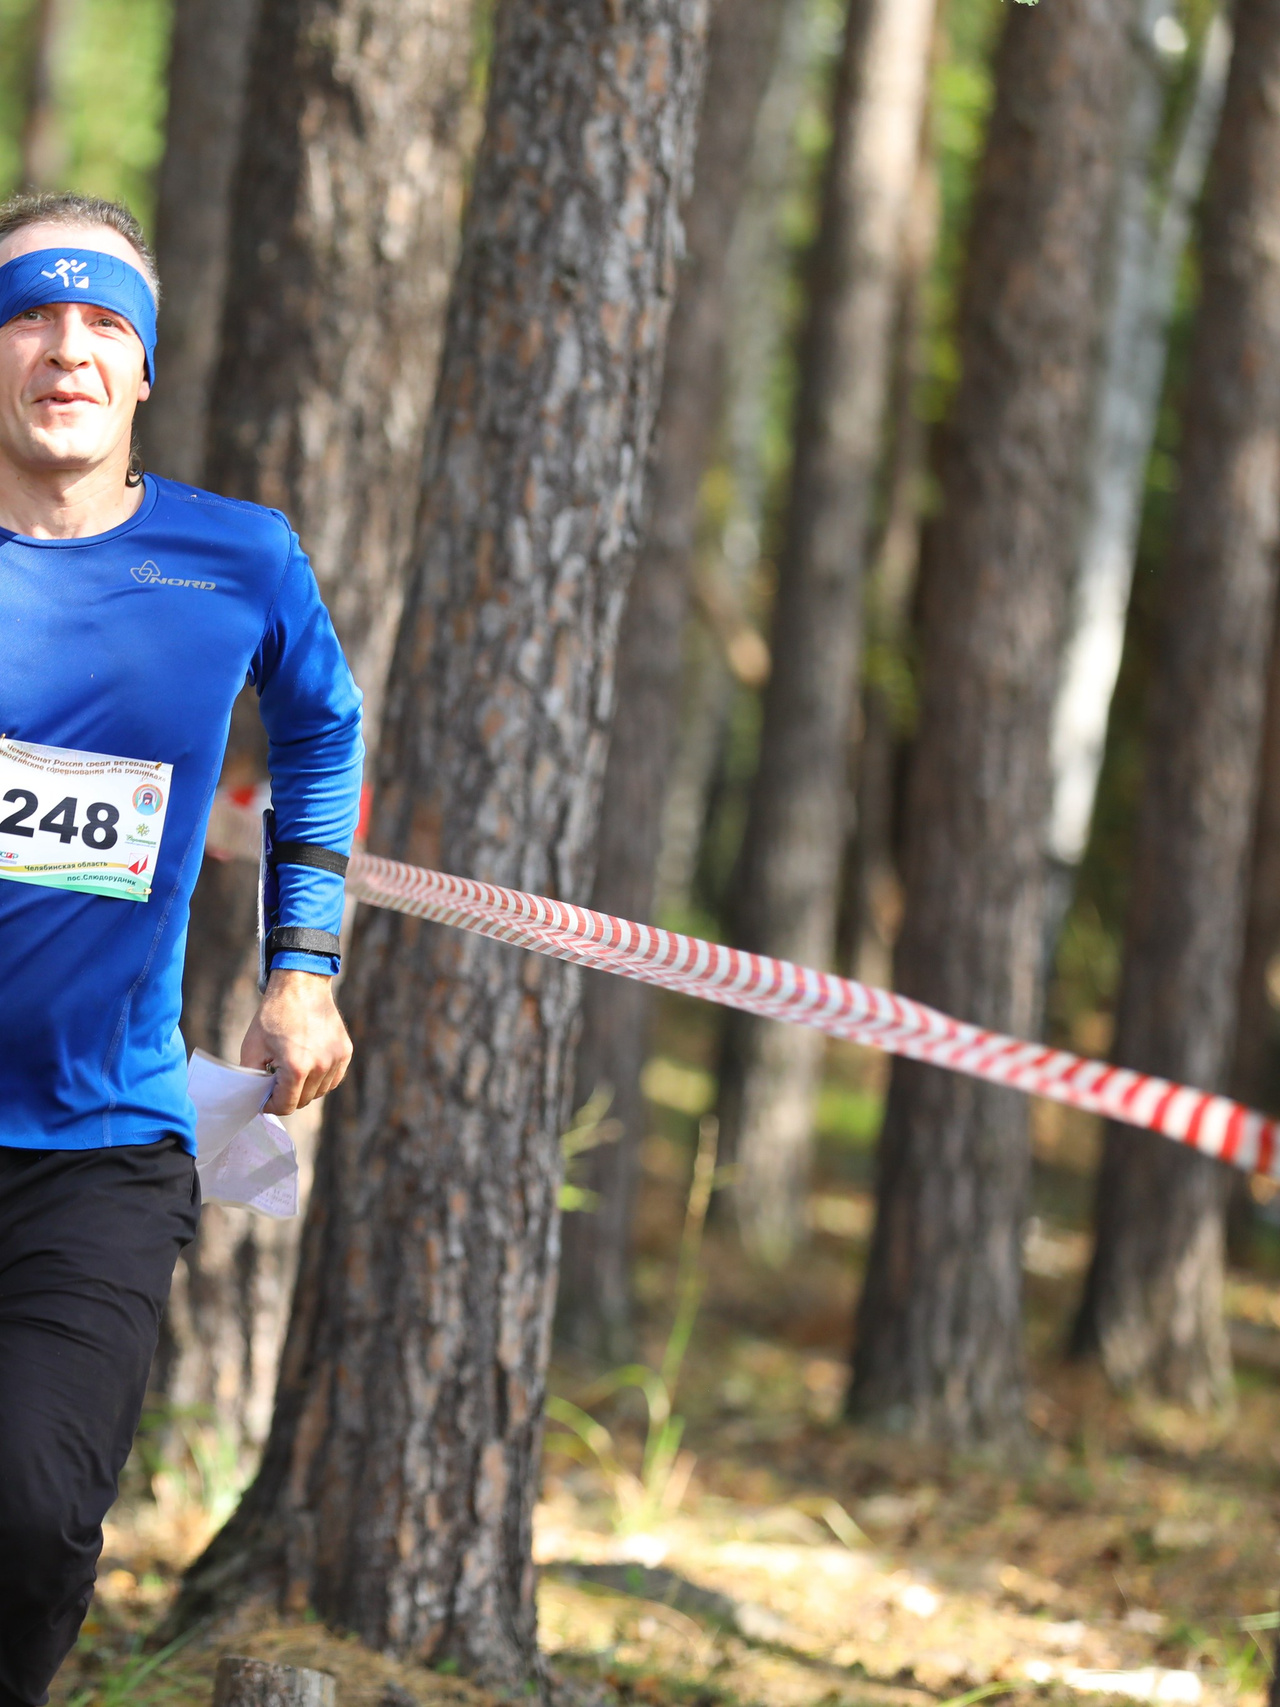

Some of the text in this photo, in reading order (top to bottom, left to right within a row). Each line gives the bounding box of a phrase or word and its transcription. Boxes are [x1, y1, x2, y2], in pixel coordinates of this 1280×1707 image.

[149, 577, 216, 591] NORD
[53, 758, 84, 768] России
[24, 860, 108, 872] Челябинская область
